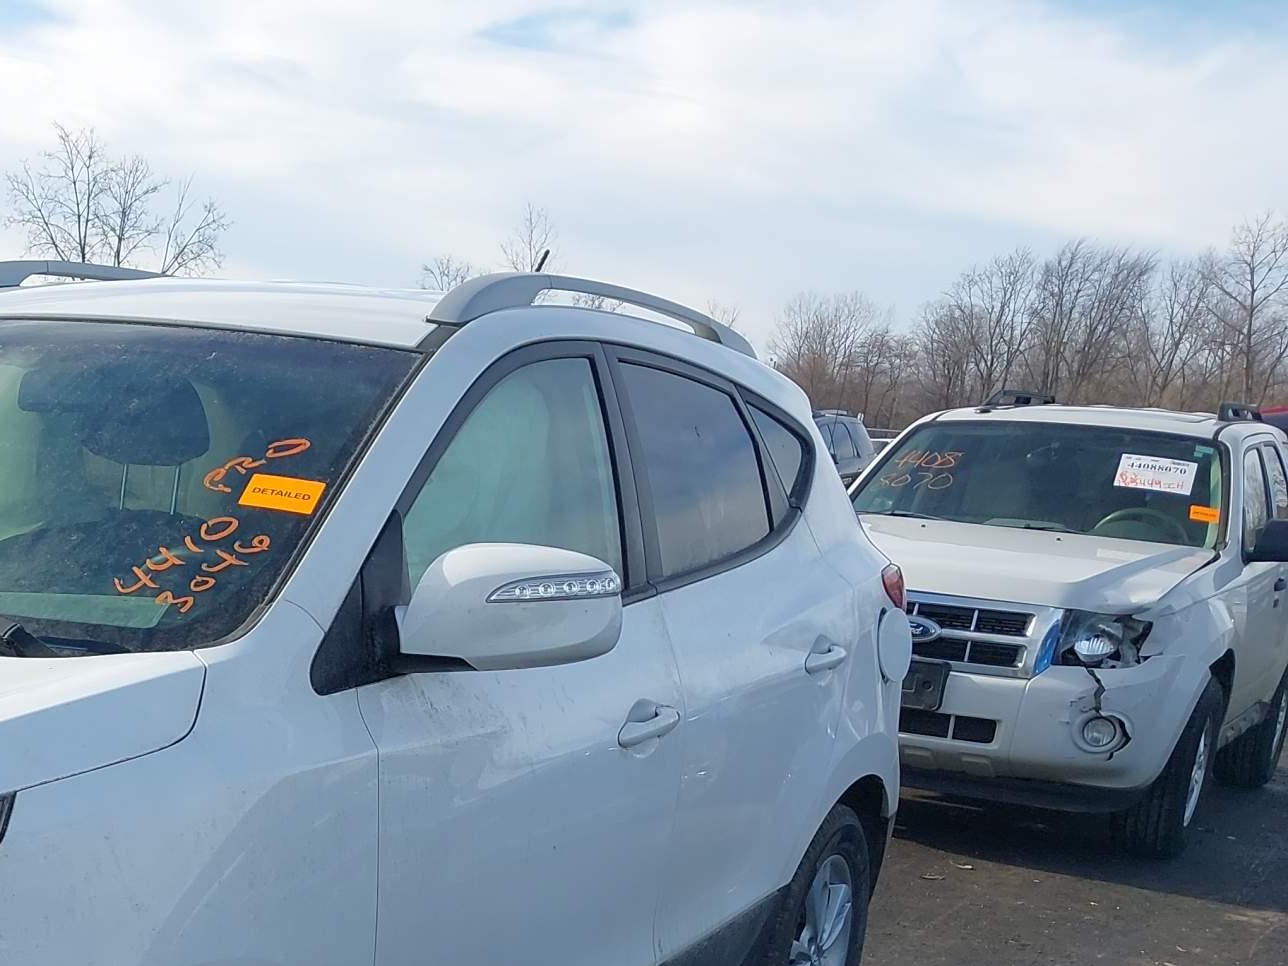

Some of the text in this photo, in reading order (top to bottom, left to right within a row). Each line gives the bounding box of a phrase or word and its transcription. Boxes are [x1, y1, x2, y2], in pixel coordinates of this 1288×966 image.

[1127, 461, 1187, 475] 44088070
[251, 486, 312, 502] DETAILED
[114, 516, 239, 594] 4410
